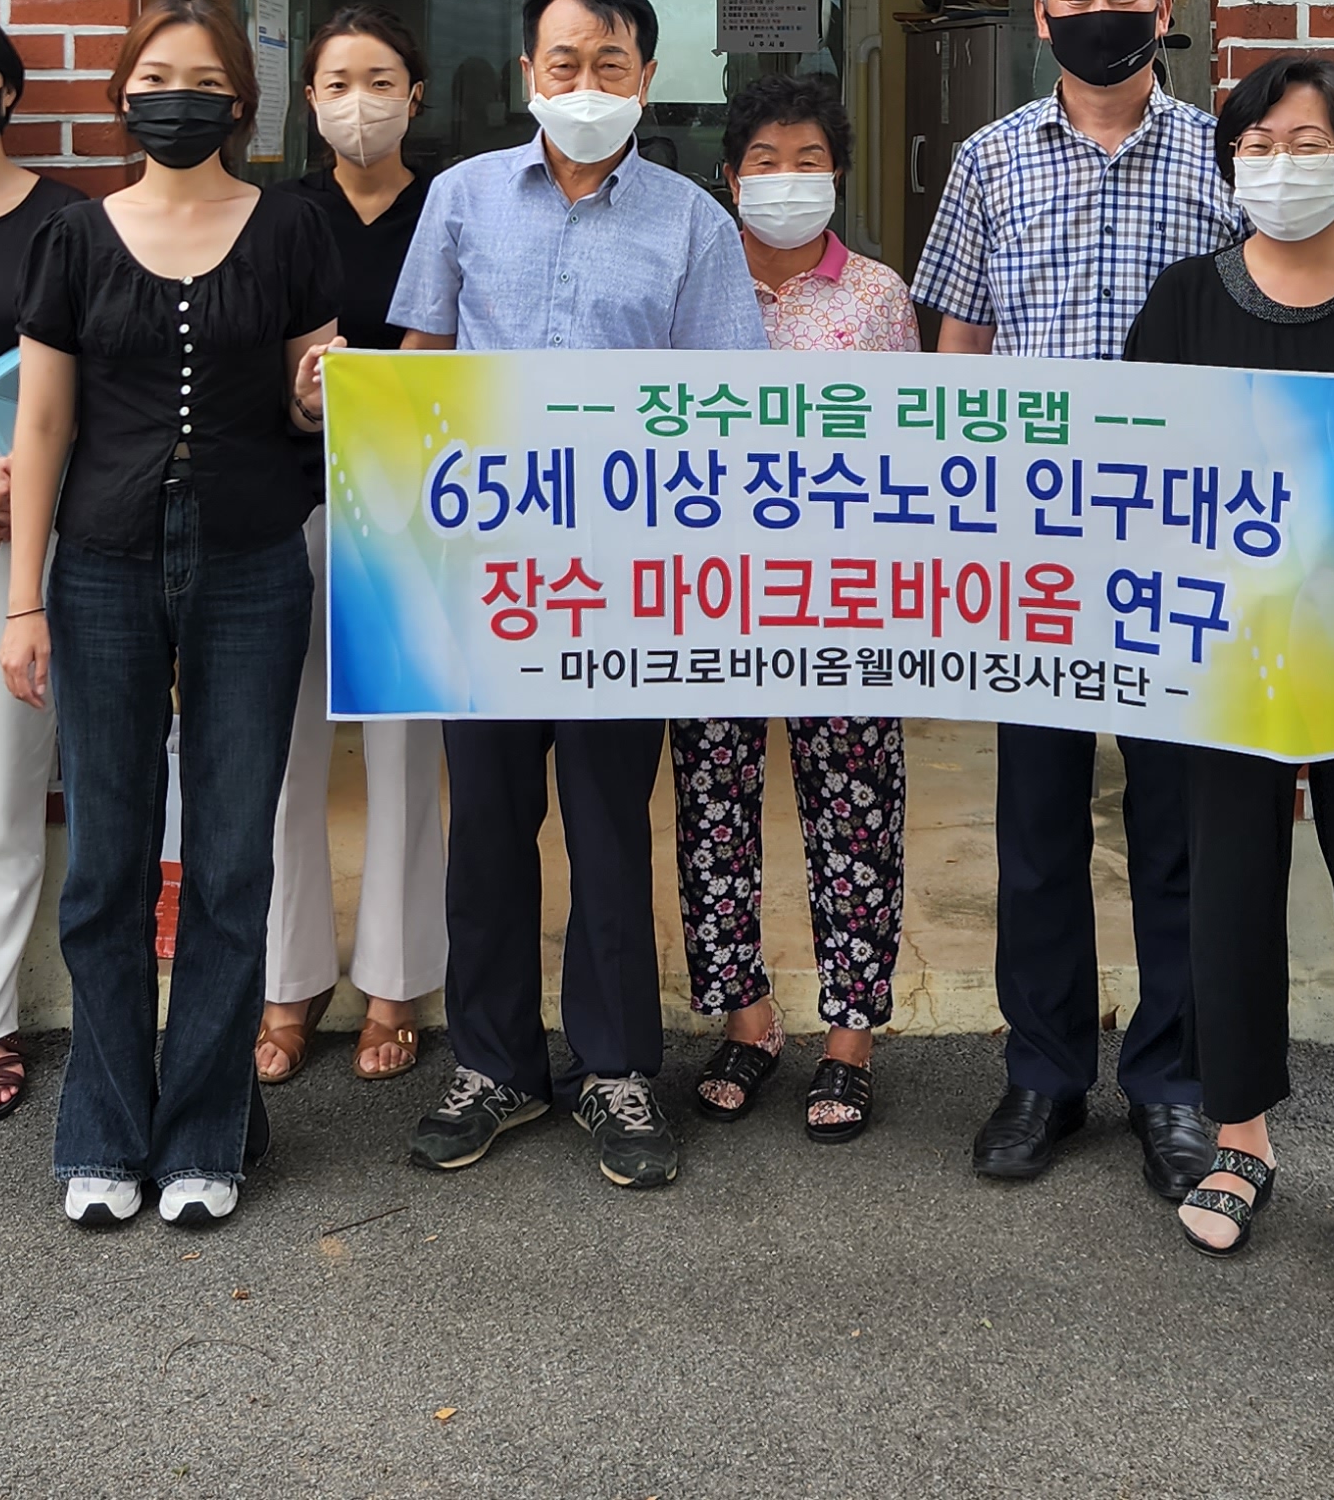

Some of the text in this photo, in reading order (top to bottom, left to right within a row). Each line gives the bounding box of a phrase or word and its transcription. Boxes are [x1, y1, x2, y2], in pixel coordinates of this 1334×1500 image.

[636, 382, 1070, 445] 장수마을 리빙랩
[429, 446, 1292, 558] 65세 이상 장수노인 인구대상
[481, 553, 1231, 664] 장수 마이크로바이옴 연구
[559, 646, 1152, 707] 마이크로바이옴웰에이징사업단
